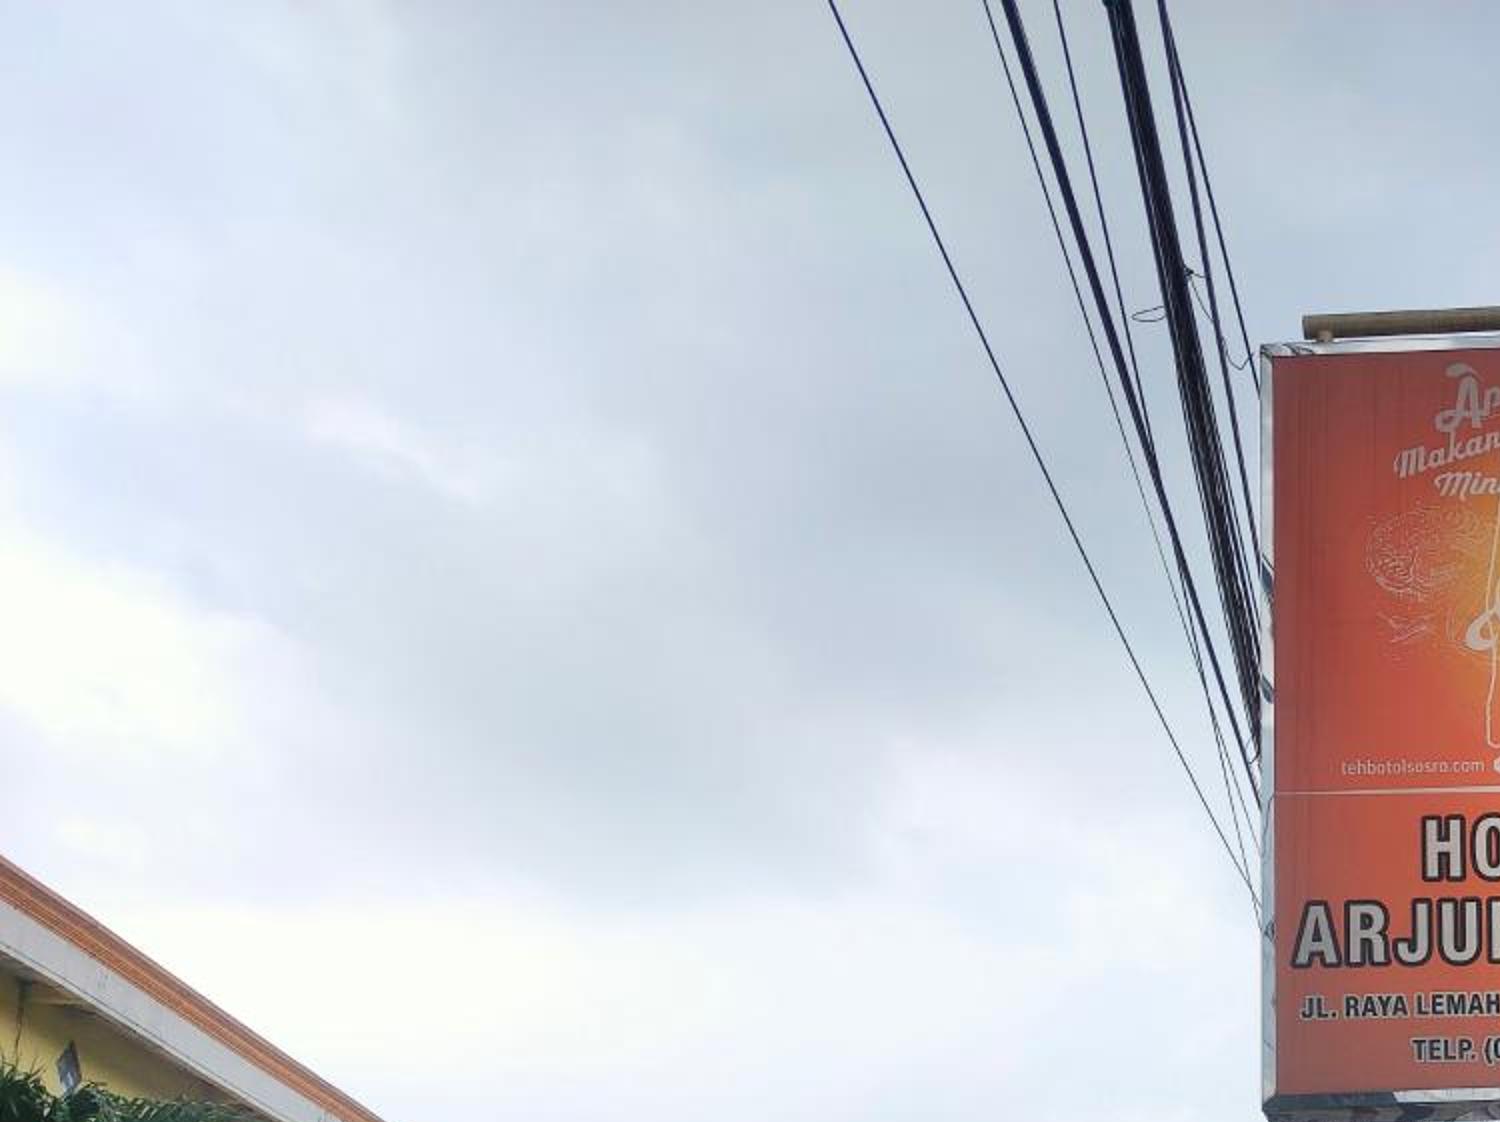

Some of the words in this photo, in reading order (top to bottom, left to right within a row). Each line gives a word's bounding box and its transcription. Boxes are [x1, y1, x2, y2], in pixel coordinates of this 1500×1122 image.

[1342, 757, 1484, 776] tehbotolsosro.com
[1301, 997, 1337, 1020] JL.
[1344, 994, 1407, 1018] RAYA
[1416, 991, 1500, 1016] LEMAH
[1413, 1038, 1476, 1062] TELP.
